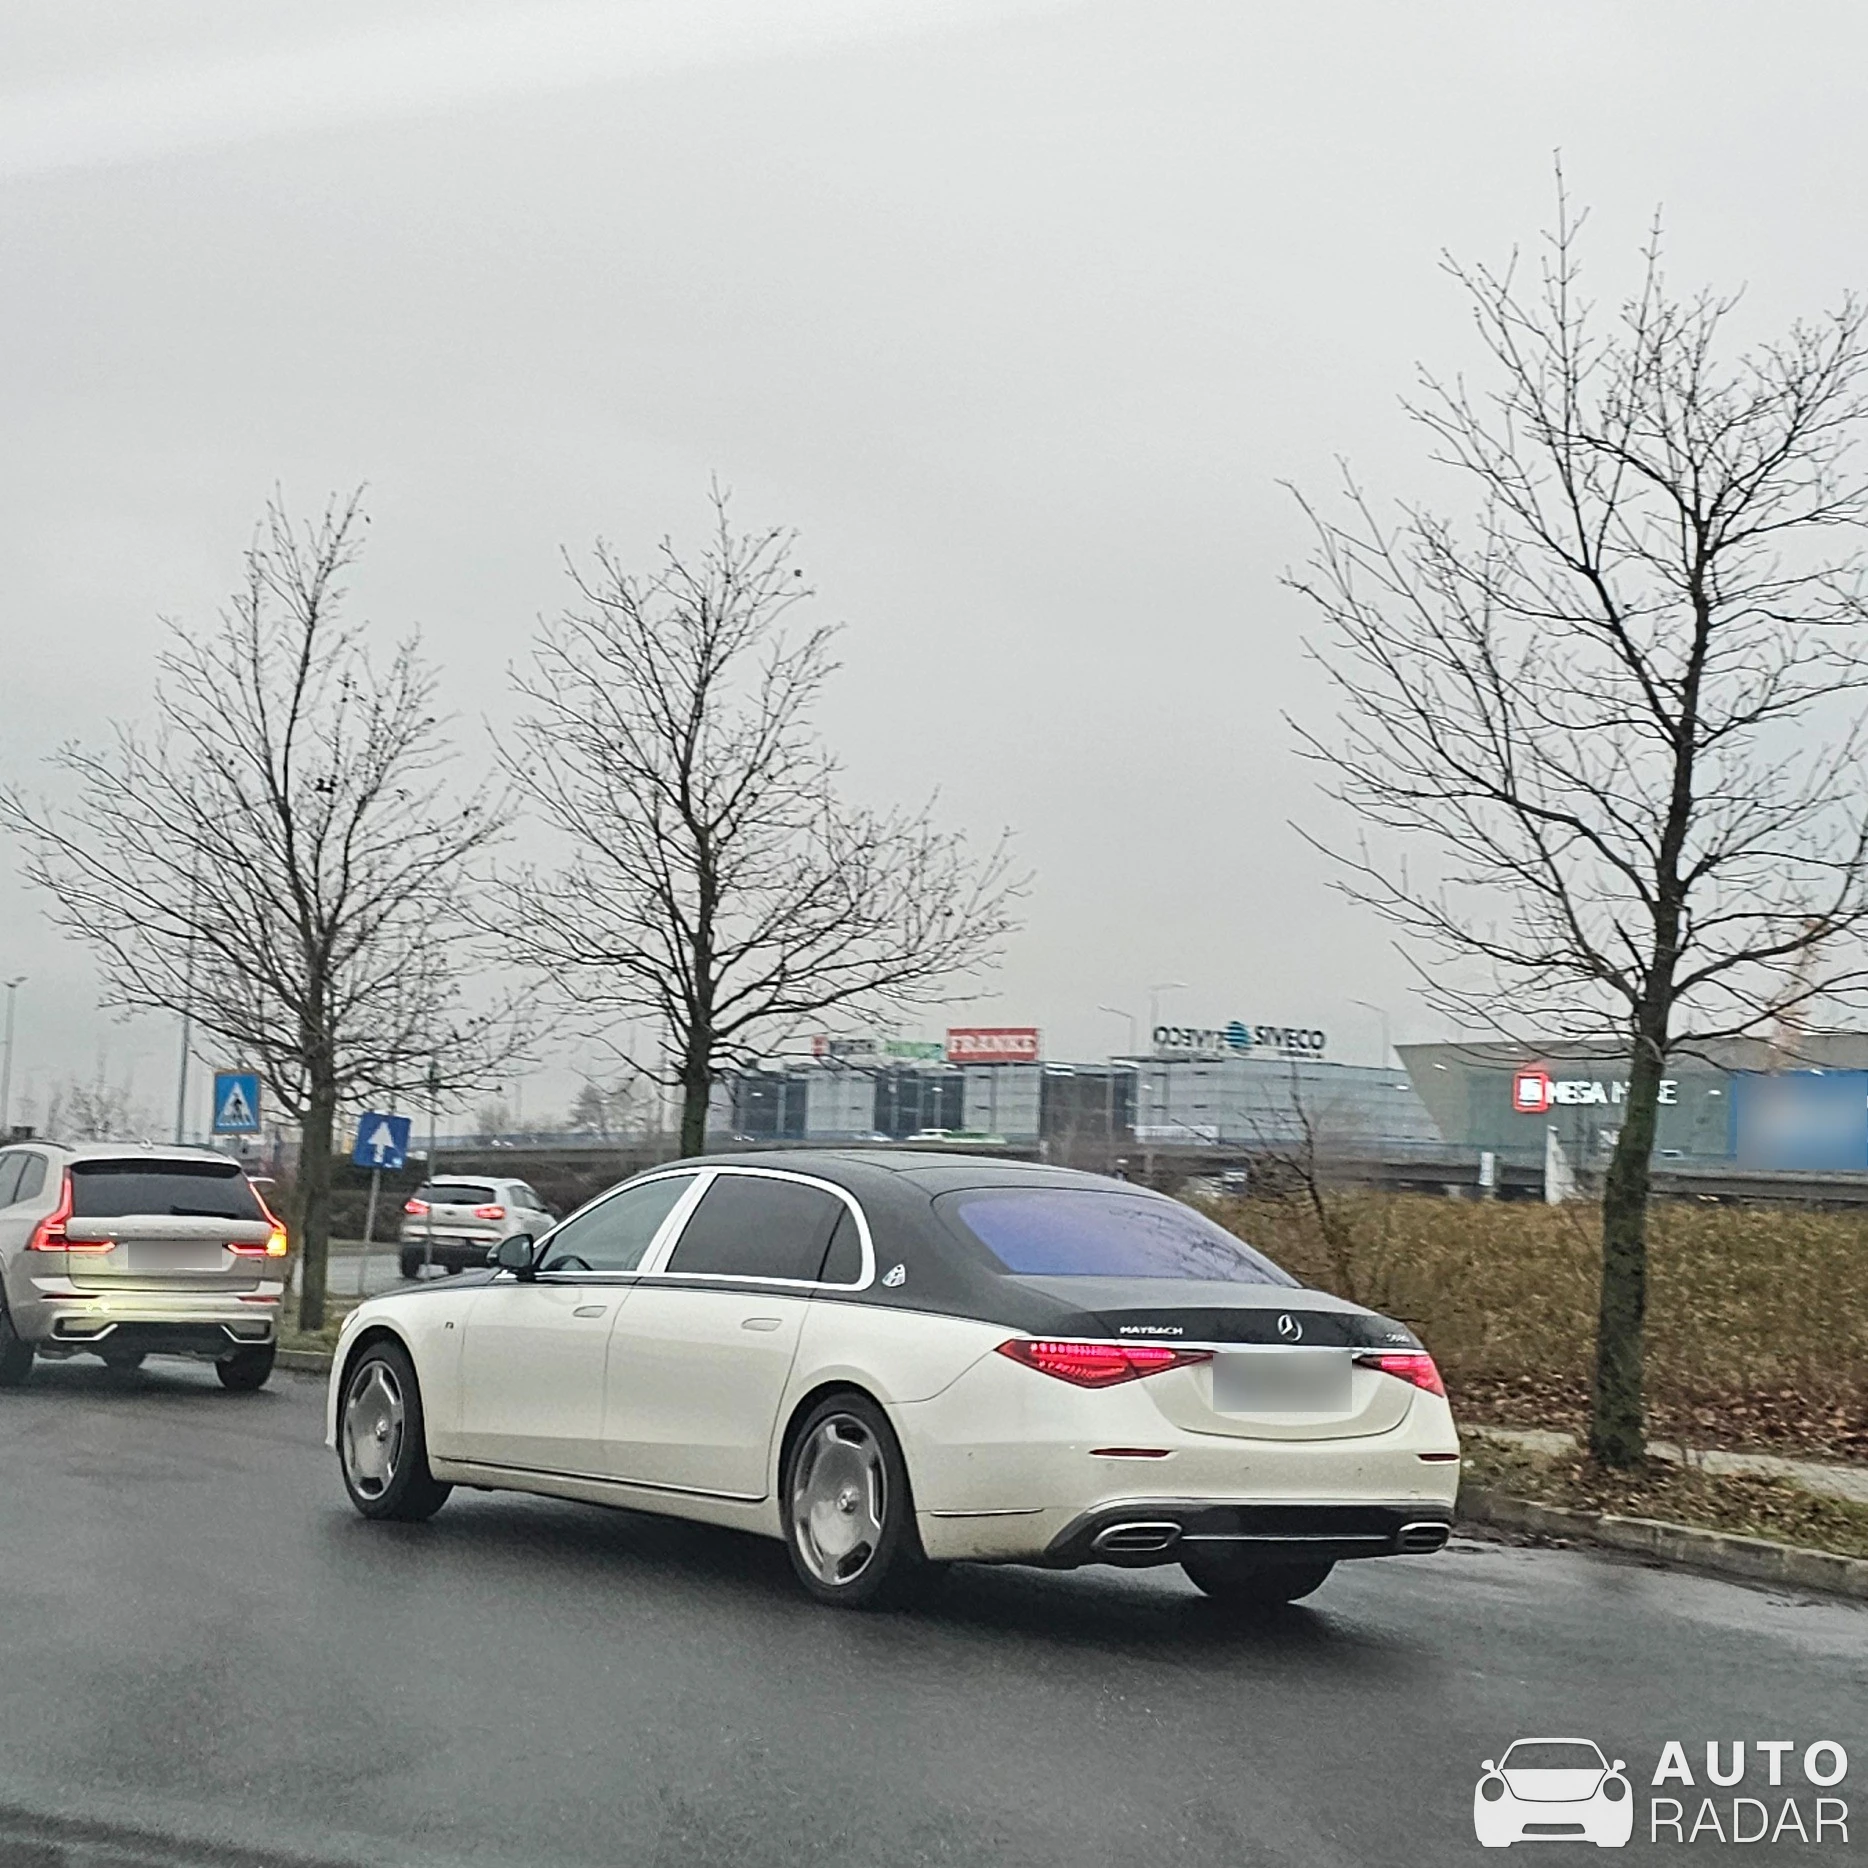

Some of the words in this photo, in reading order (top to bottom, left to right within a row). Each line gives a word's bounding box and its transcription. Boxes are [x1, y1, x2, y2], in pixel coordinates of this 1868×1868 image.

[951, 1034, 1037, 1054] FRANKE
[1255, 1026, 1326, 1050] SIVECO
[1119, 1326, 1183, 1335] MAYBACH
